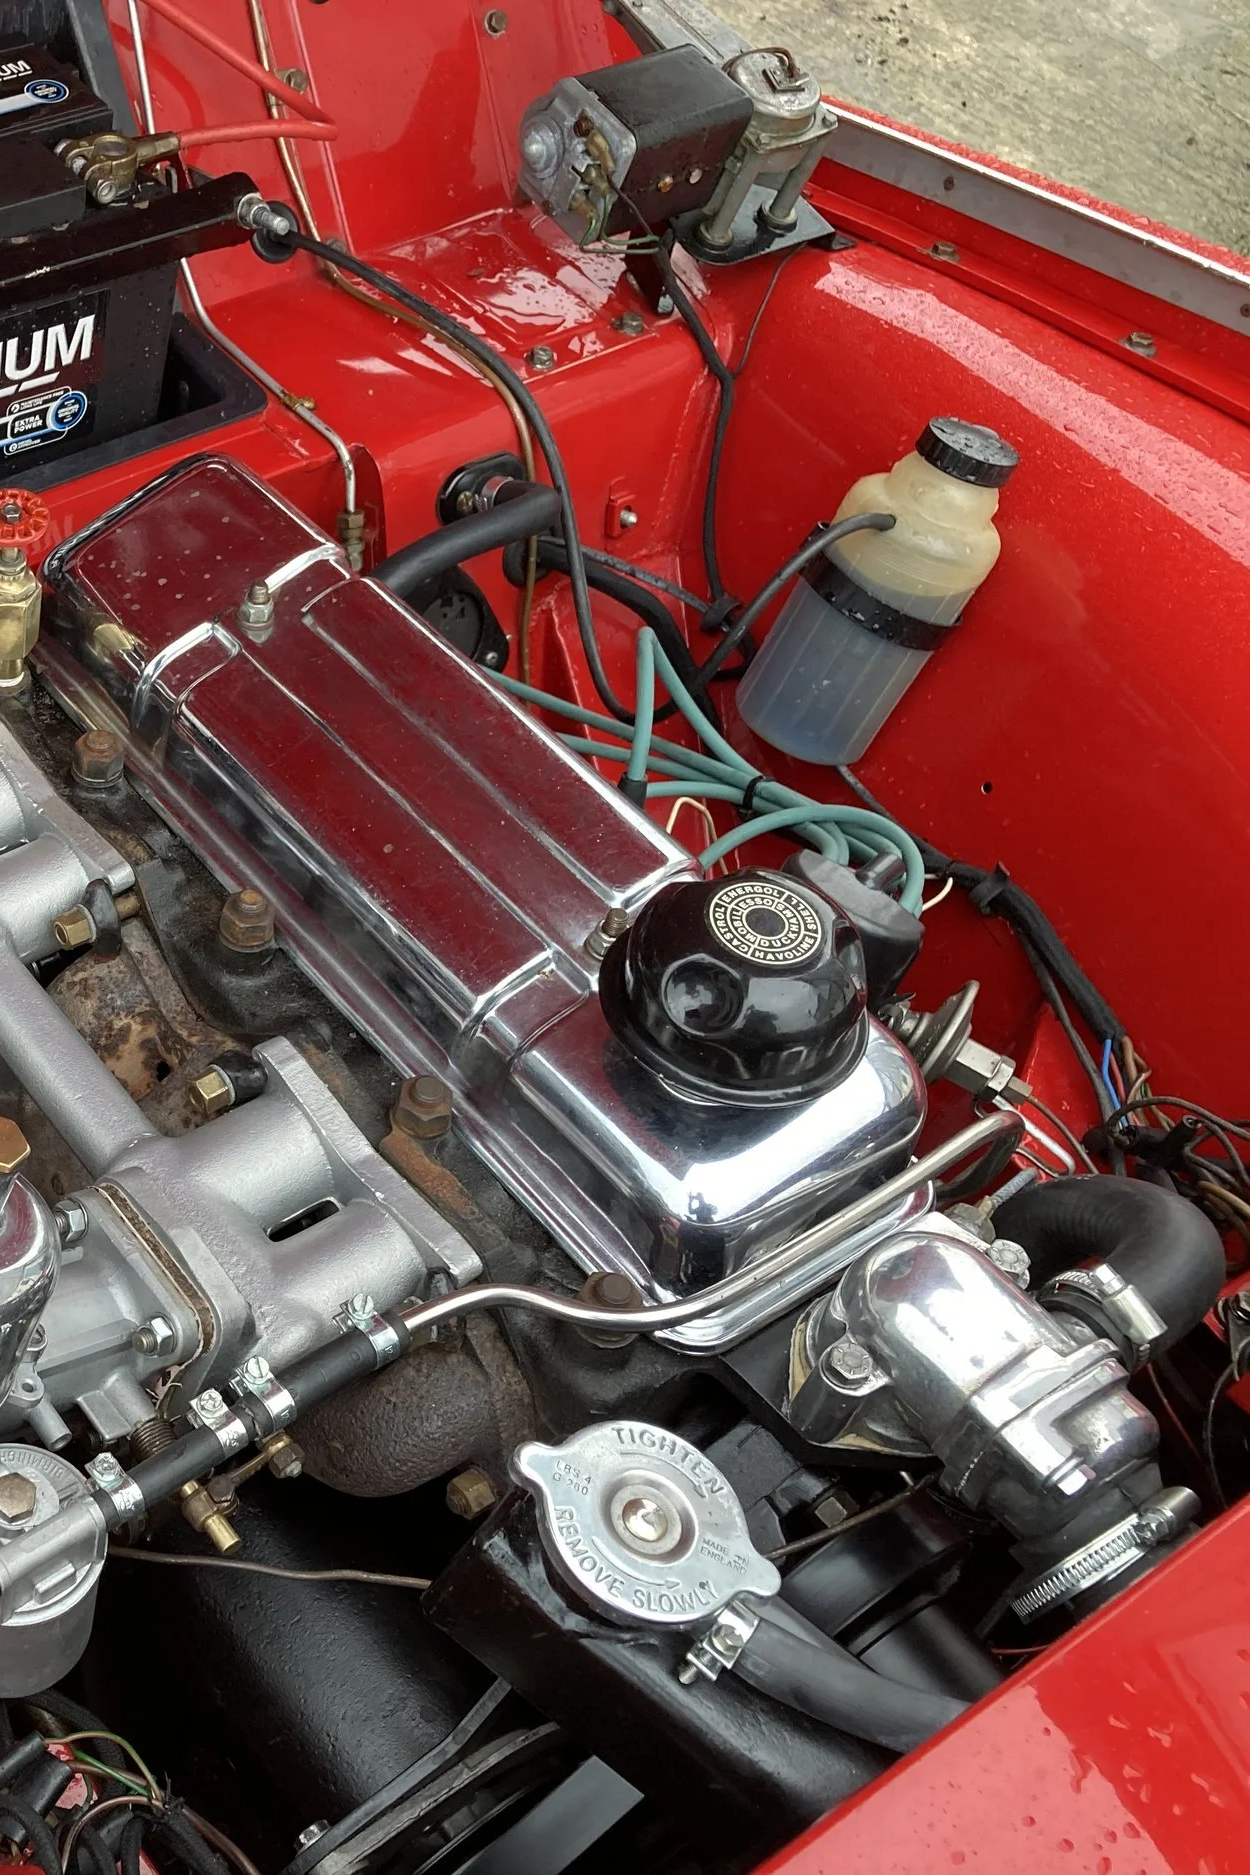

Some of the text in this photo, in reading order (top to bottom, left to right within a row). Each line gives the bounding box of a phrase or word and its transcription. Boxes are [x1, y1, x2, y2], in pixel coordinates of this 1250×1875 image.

[14, 414, 41, 428] EXTRA
[14, 420, 43, 434] POWER
[722, 885, 780, 902] ENERGOL
[738, 897, 773, 908] ESSO
[732, 910, 757, 942] MOBIL
[760, 902, 800, 947] DUCKHAMS
[791, 897, 817, 931] SHELL
[715, 906, 749, 953] CASTROL
[754, 935, 815, 961] HAVOLINE
[611, 1425, 727, 1495] TIGHTEN
[554, 1505, 625, 1598] REMOVE
[700, 1547, 748, 1575] ENGLAND
[702, 1537, 730, 1556] MADE
[633, 1580, 719, 1613] SLOWLY
